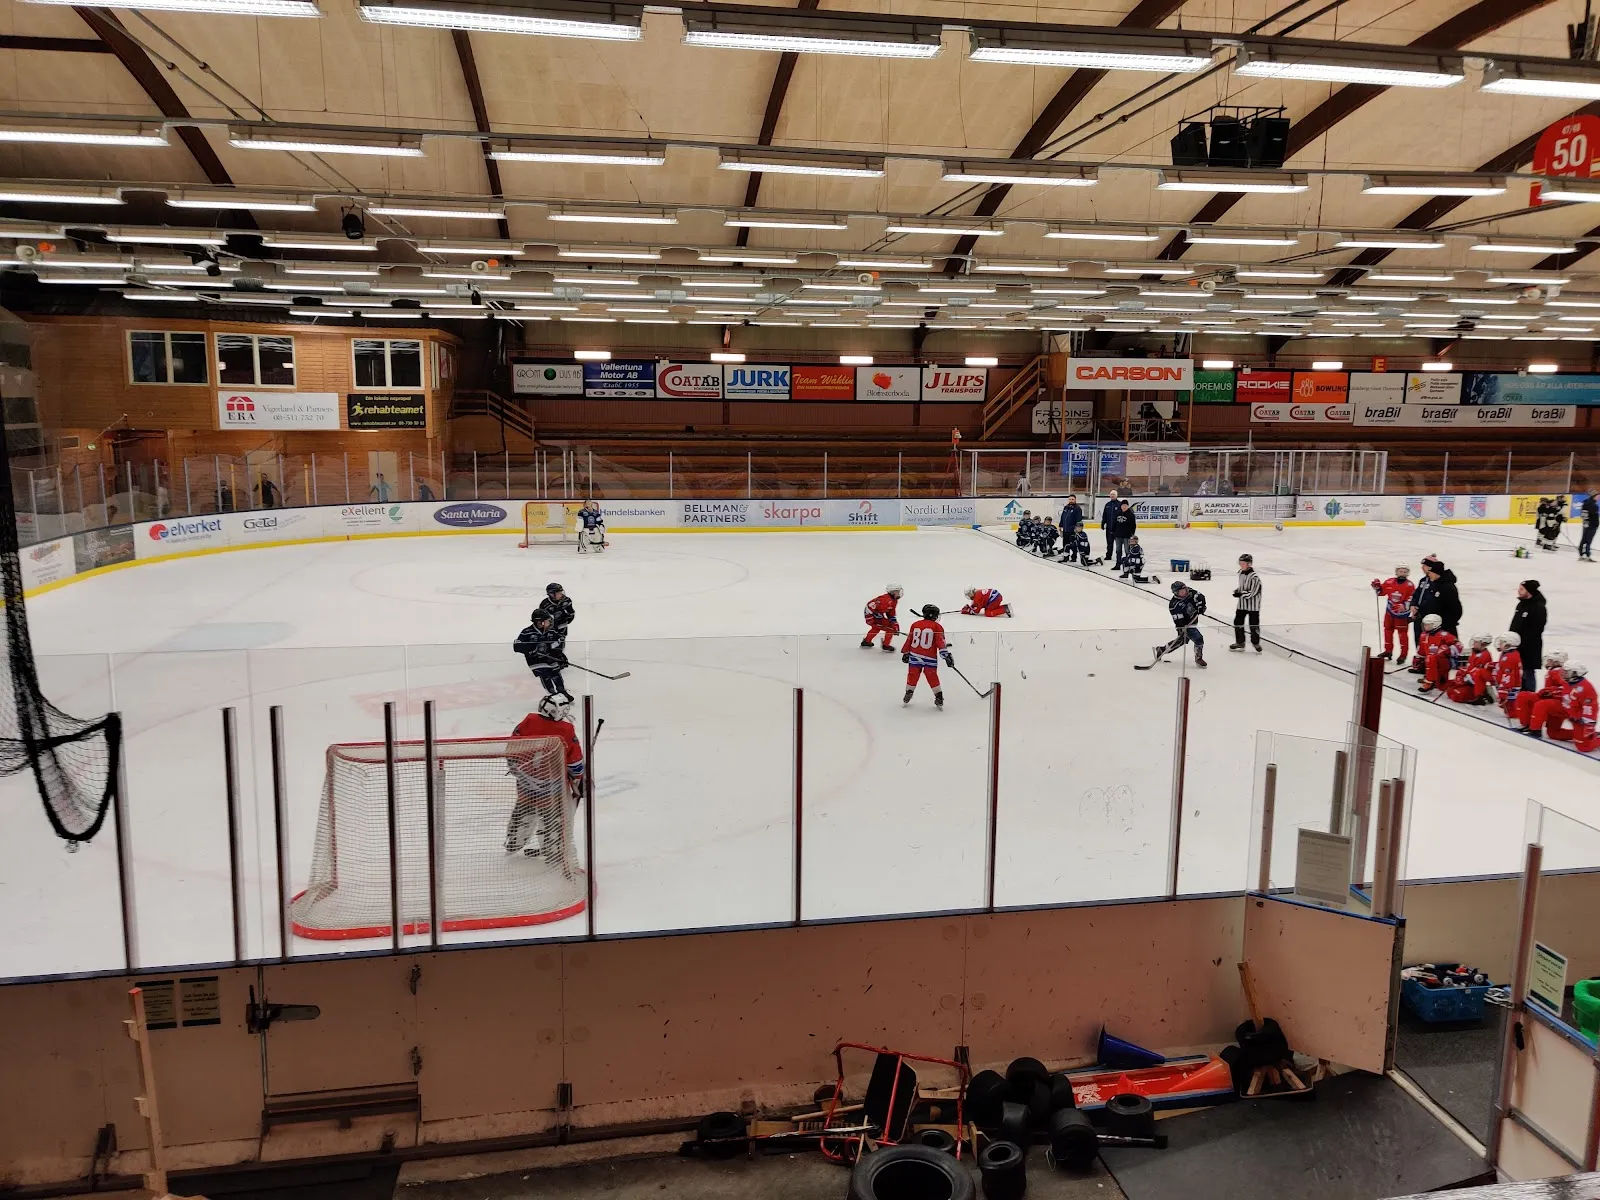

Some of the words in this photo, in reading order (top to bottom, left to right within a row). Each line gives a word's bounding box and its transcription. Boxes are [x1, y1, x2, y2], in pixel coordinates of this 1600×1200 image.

[1552, 134, 1587, 170] 50
[600, 363, 643, 371] Vallentuna
[1375, 359, 1384, 371] E
[727, 369, 789, 387] JURK
[1075, 366, 1182, 381] CARSON
[792, 373, 818, 385] Team
[1193, 382, 1232, 391] OREMUS
[1237, 380, 1290, 389] ROOKIE
[1316, 384, 1347, 392] BOWLING
[306, 405, 334, 413] Partners
[364, 405, 425, 414] rehabteamet
[1365, 407, 1402, 418] braBil
[1421, 408, 1459, 418] braBil
[1477, 408, 1513, 419] braBil
[1531, 408, 1566, 419] braBil
[228, 412, 256, 420] ERA
[341, 506, 386, 516] eXellent
[600, 508, 666, 516] Handelsbanken
[764, 502, 821, 525] skarpa
[905, 504, 938, 515] Nordic
[942, 504, 973, 514] House
[1325, 502, 1341, 515] GK
[440, 509, 469, 519] Santa
[470, 509, 501, 518] Maria
[684, 514, 746, 523] PARTNERS
[848, 512, 878, 522] Shift
[171, 519, 222, 536] elverket
[911, 627, 934, 650] 80
